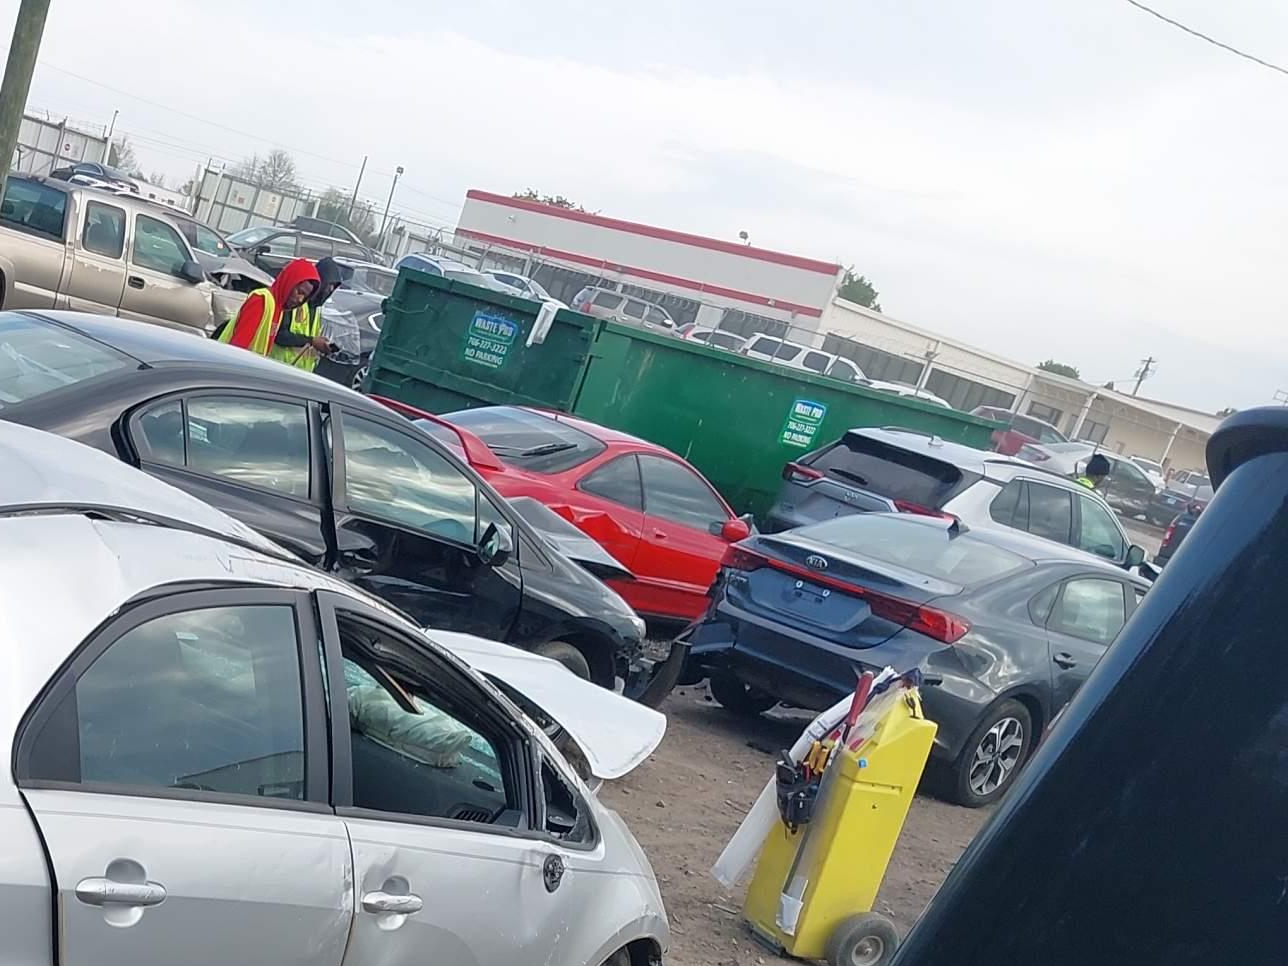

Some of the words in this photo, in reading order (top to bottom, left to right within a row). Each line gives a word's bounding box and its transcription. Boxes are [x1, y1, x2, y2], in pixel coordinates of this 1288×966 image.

[474, 317, 498, 334] WASTE
[464, 347, 475, 357] NO
[475, 350, 504, 366] PARKING
[783, 430, 792, 440] NO
[807, 555, 827, 569] KIA
